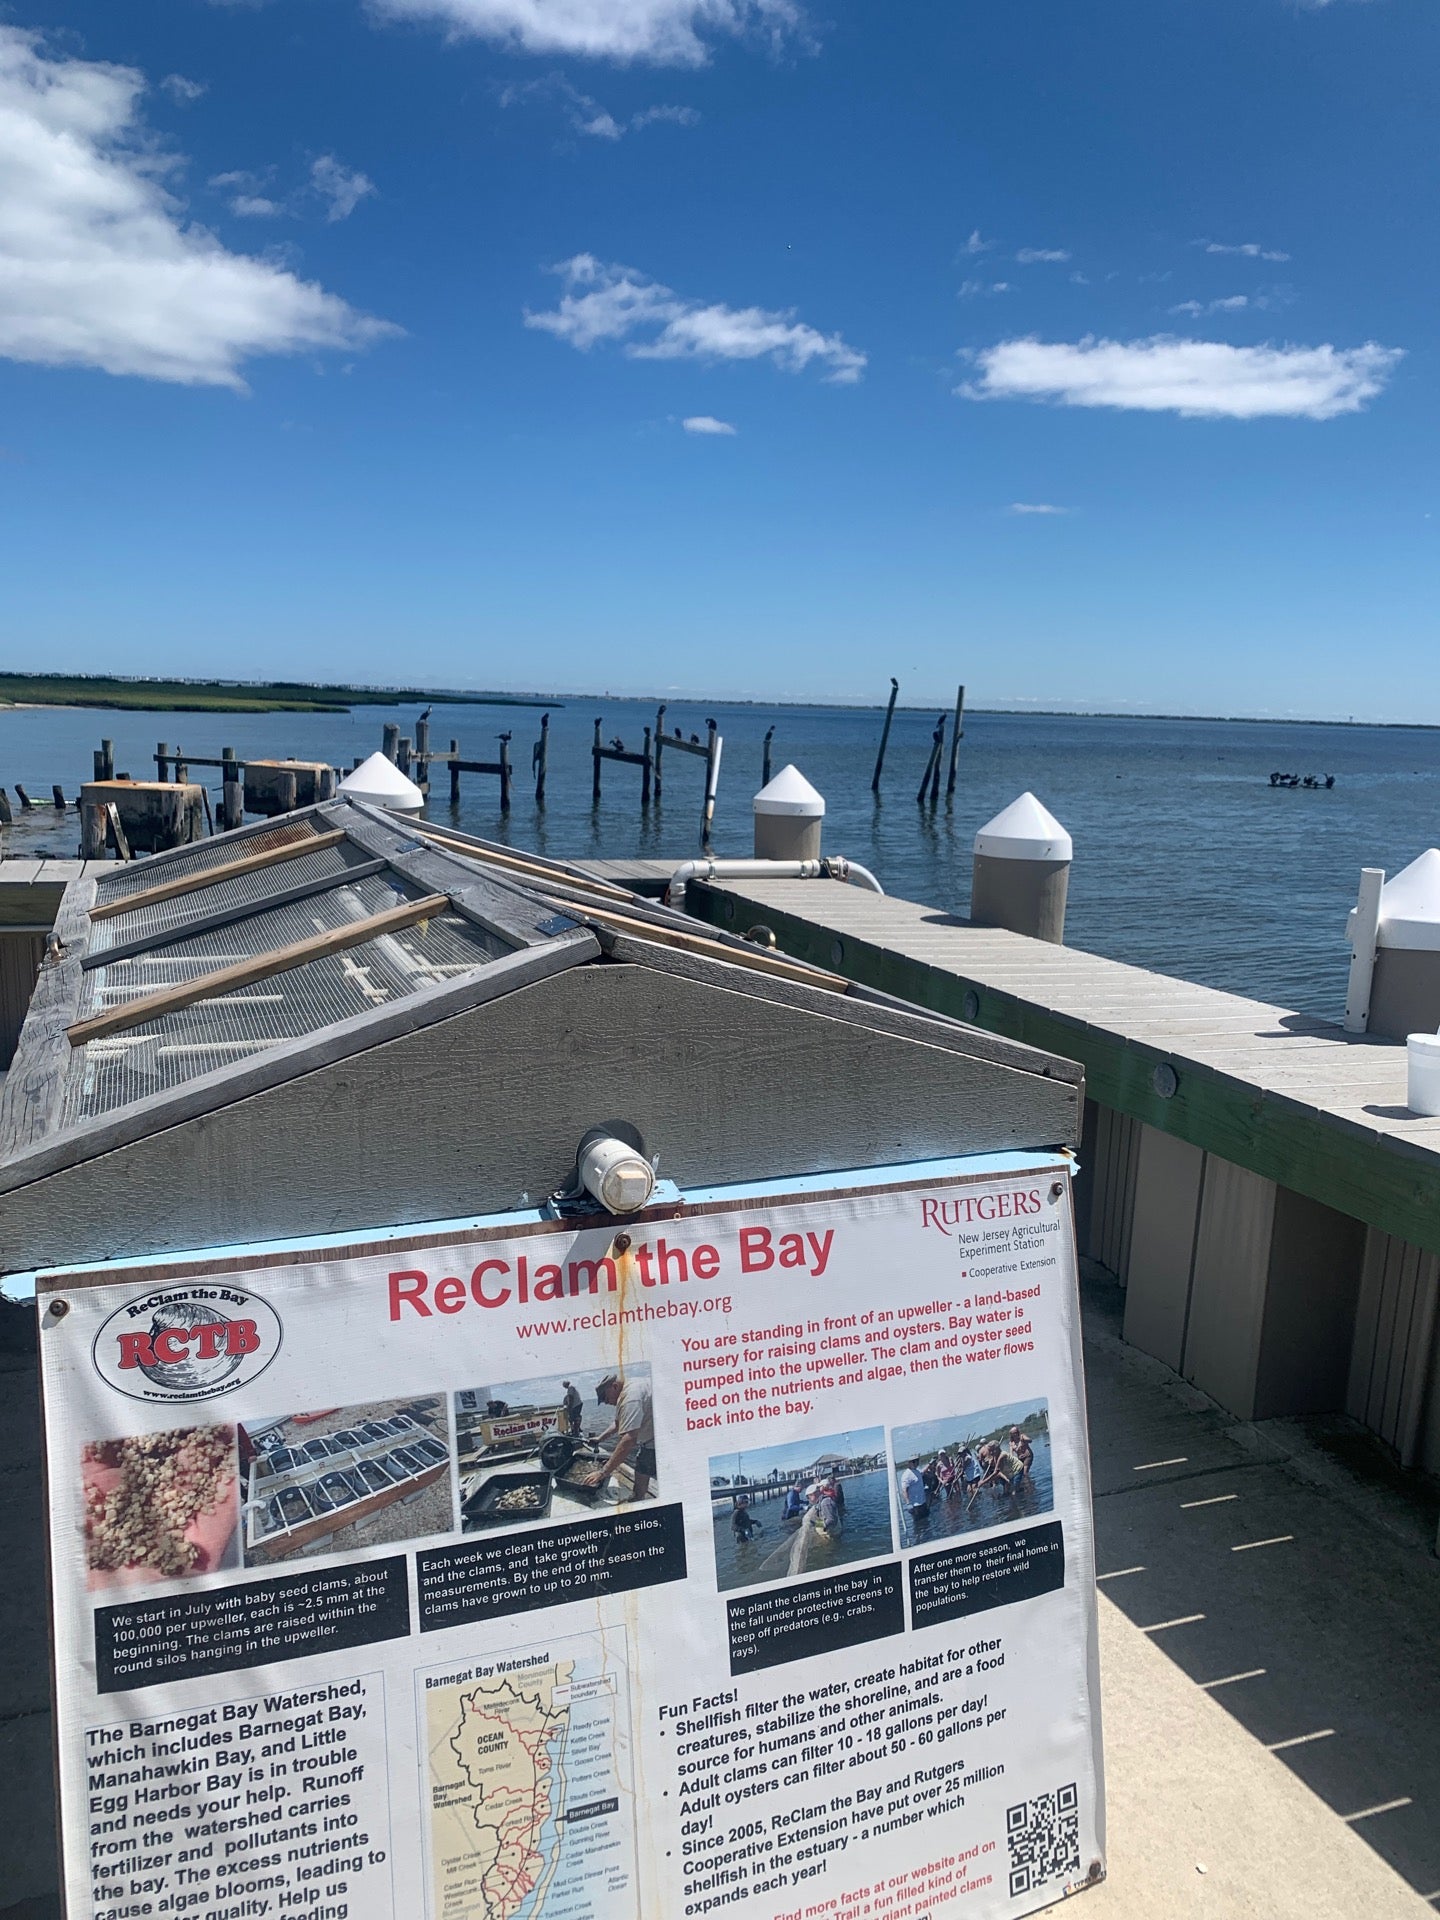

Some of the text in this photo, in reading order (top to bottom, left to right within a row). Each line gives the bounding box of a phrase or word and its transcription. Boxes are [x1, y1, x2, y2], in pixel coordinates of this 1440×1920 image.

[921, 1190, 1041, 1236] RUTGERS
[958, 1219, 1060, 1244] New Jersey Agricultural
[960, 1238, 1045, 1259] Experiment Station
[969, 1257, 1056, 1278] Cooperative Extension
[389, 1226, 834, 1321] ReClam the Bay
[126, 1288, 249, 1318] ReClam the Bay
[516, 1294, 732, 1339] www.reclamthebay.org
[117, 1319, 260, 1369] RCTB
[683, 1306, 1024, 1372] nursery for raising clams and oysters. Bay water is
[144, 1377, 241, 1400] www.reclamthebay.org
[686, 1400, 814, 1431] back into the bay.
[422, 1520, 662, 1572] Each week we clean the upwellers, the silos,
[913, 1539, 1026, 1574] After one more season, we
[424, 1546, 665, 1601] measurements. By the end of the season the
[112, 1570, 388, 1627] We start in July with baby seed clams, about
[113, 1586, 385, 1642] 100,000 per upweller, each is ~2.5 mm at the
[729, 1575, 882, 1618] We plant the clams in the bay in
[730, 1586, 894, 1631] the fall under protective screens to
[426, 1652, 549, 1688] Barnegat Bay Watershed
[676, 1638, 1002, 1736] Shellfish filter the water, create habitat for other
[85, 1679, 366, 1746] The Barnegat Bay Watershed,
[659, 1688, 738, 1721] Fun Facts!
[477, 1732, 504, 1744] OCEAN
[478, 1741, 508, 1755] COUNTY
[89, 1747, 357, 1814] Egg Harbor Bay is in trouble
[433, 1780, 465, 1793] Barnegat
[433, 1793, 448, 1801] Bay
[433, 1795, 472, 1809] Watershed
[570, 1806, 600, 1818] Barnegat
[92, 1832, 369, 1902] the bay. The excess nutrients
[685, 1859, 827, 1916] expands each year!
[774, 1841, 996, 1920] Find more facts at our website and on
